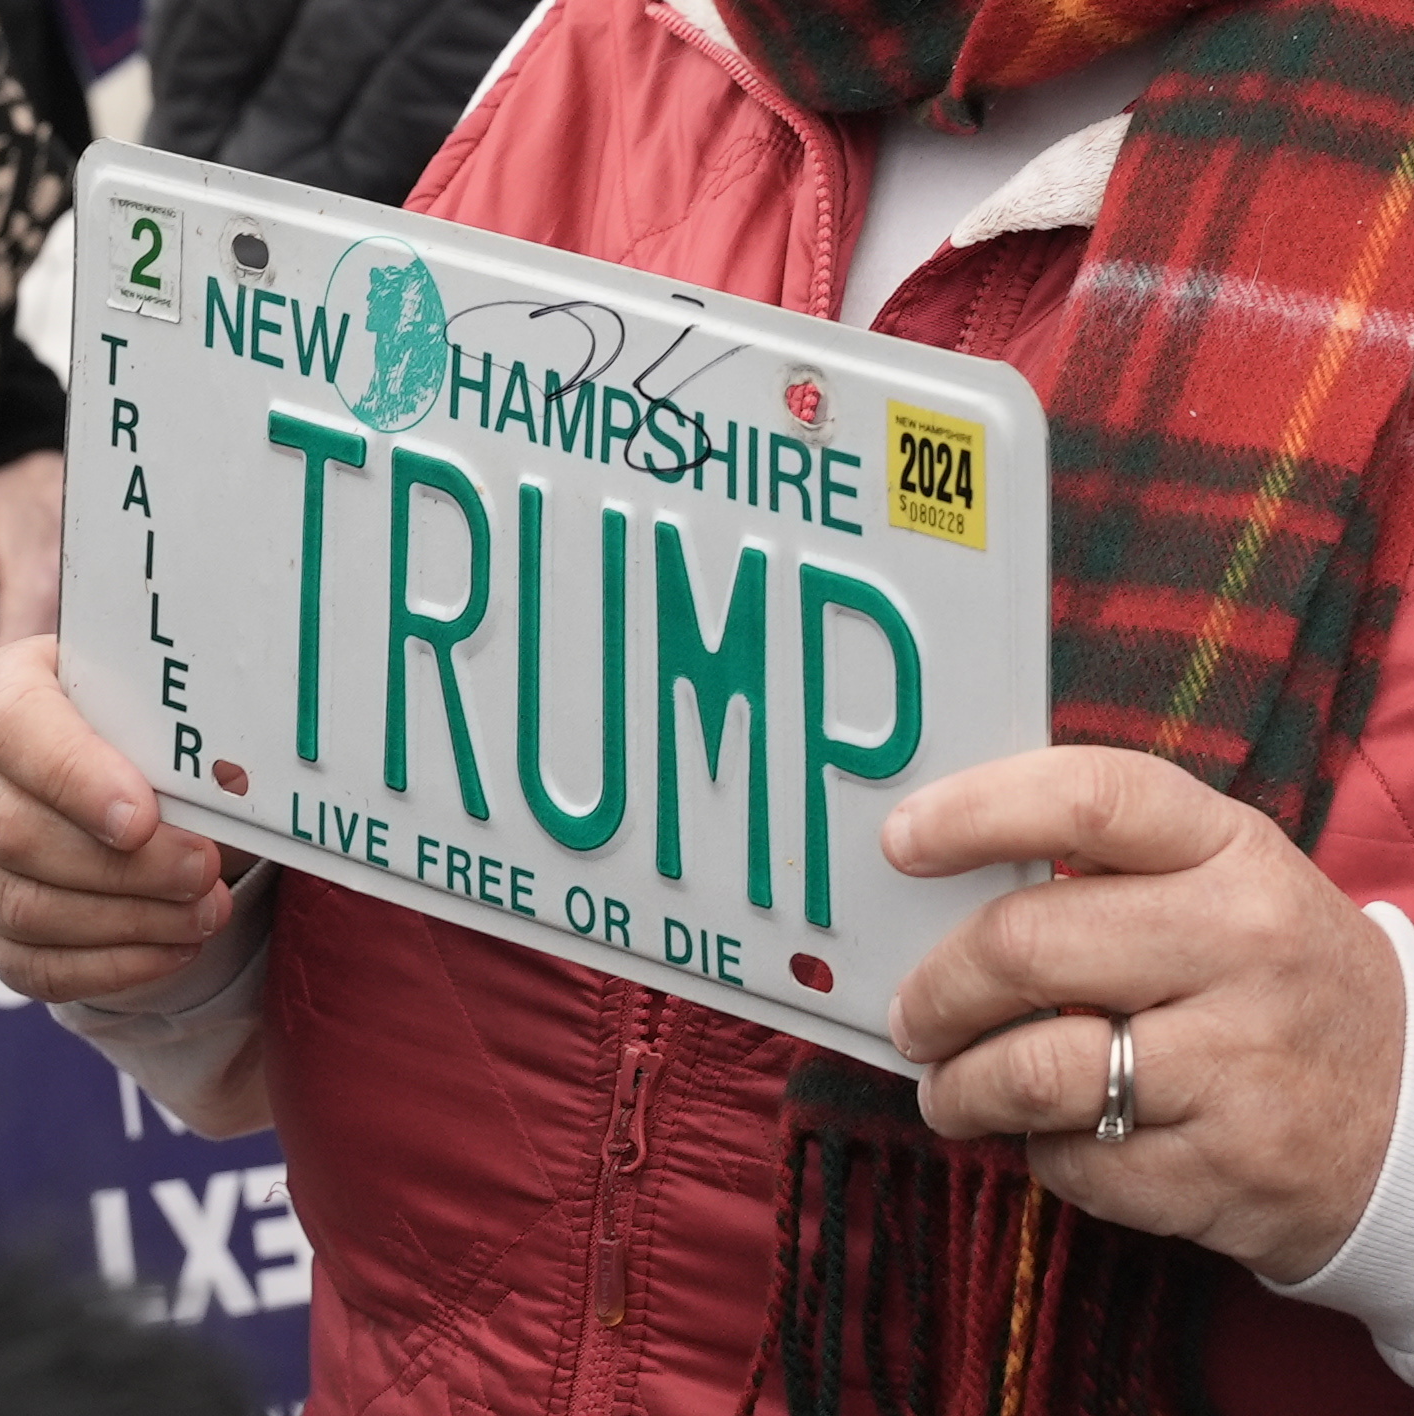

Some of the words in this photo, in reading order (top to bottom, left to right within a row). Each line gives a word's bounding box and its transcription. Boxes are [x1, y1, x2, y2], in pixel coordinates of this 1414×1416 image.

[130, 217, 163, 291] 2
[205, 275, 350, 385] NEW
[449, 342, 864, 537] HAMPSHIRE
[895, 415, 917, 429] NEW
[918, 422, 972, 446] HAMPSHIRE
[899, 432, 973, 510] 2024
[101, 333, 203, 779] TRAILER
[909, 500, 965, 535] 080228
[267, 409, 923, 927] TRUMP
[292, 791, 389, 868] LIVE
[417, 834, 536, 917] FREE
[565, 885, 631, 948] OR
[664, 917, 744, 986] DIE
